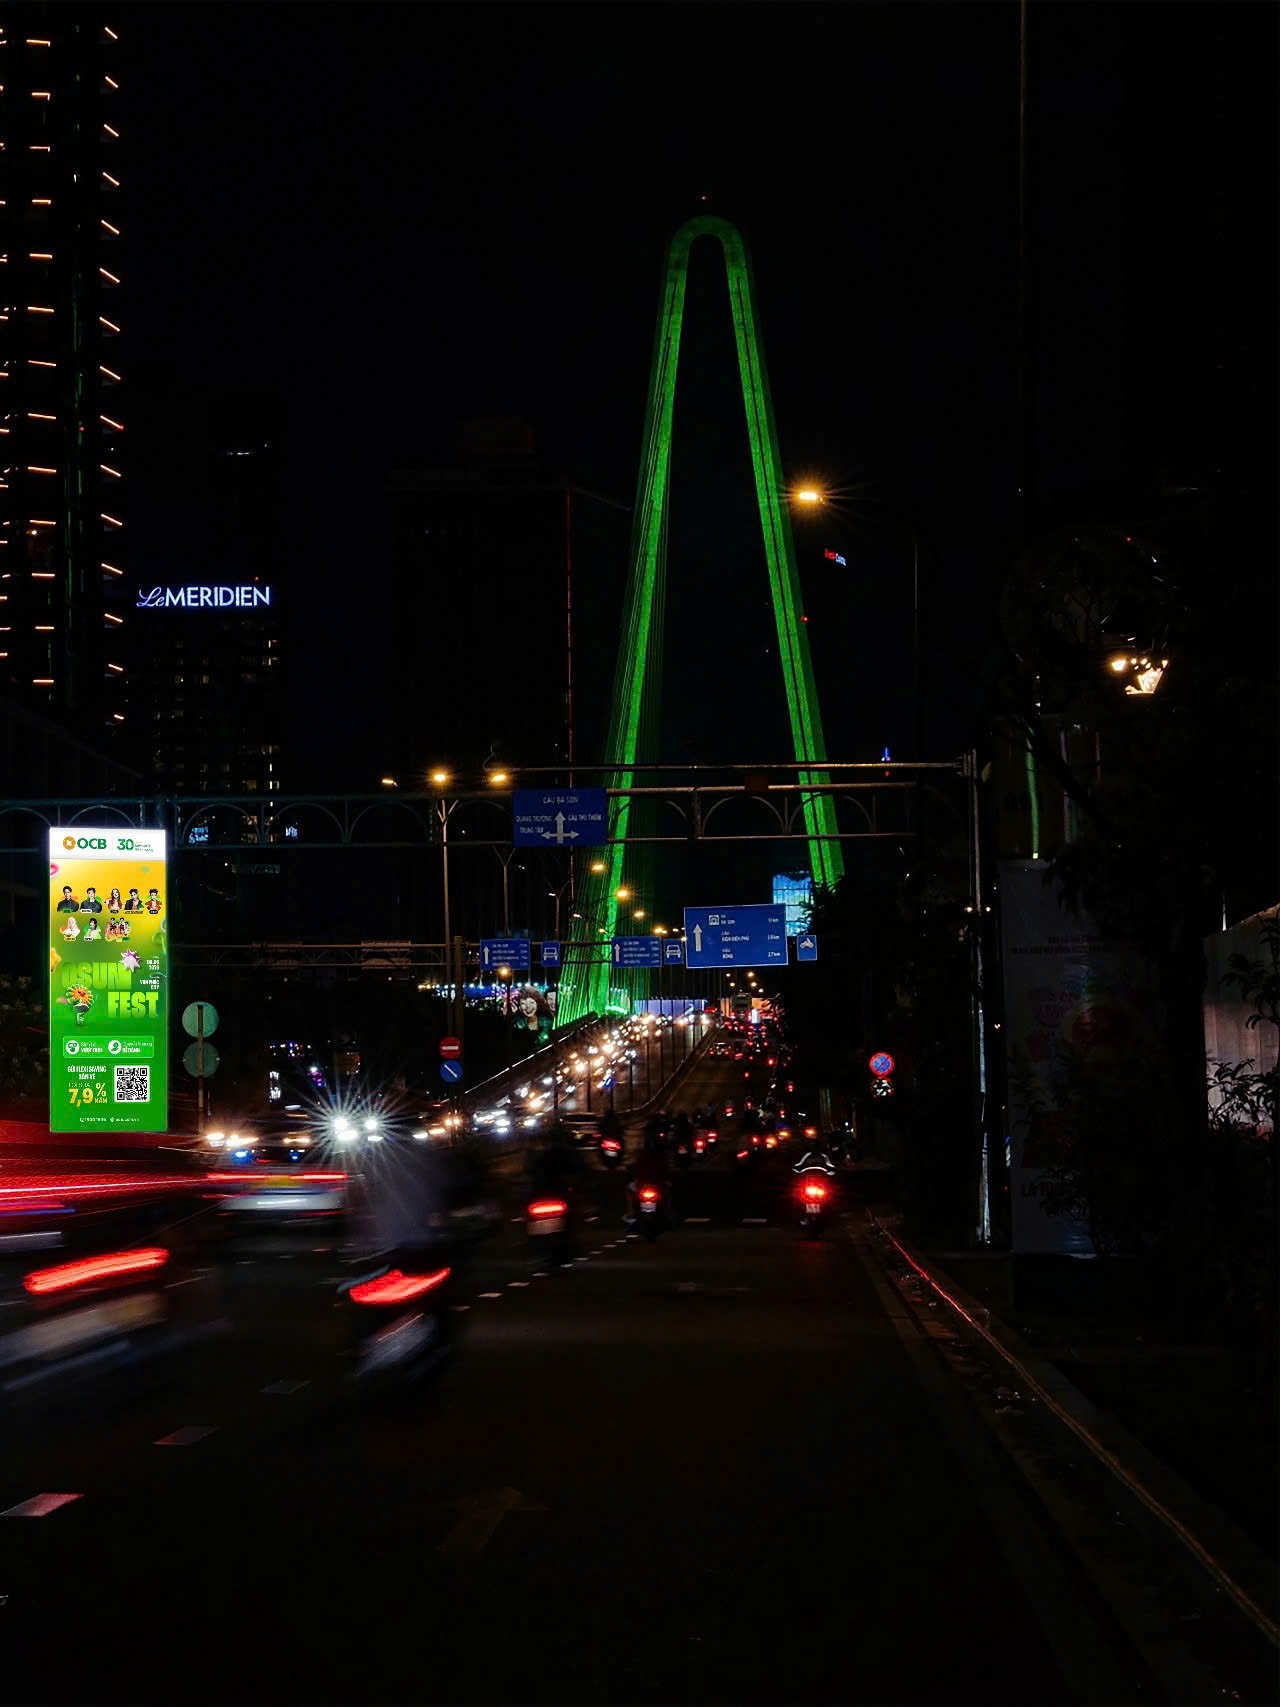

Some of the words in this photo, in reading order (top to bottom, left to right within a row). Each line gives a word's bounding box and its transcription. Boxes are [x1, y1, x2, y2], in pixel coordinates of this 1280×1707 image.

[136, 586, 164, 607] Le
[165, 586, 270, 607] MERIDIEN
[77, 838, 107, 849] OCB
[117, 839, 134, 851] 30
[108, 992, 159, 1019] FEST
[69, 1088, 93, 1107] 7,9
[96, 1083, 106, 1097] %
